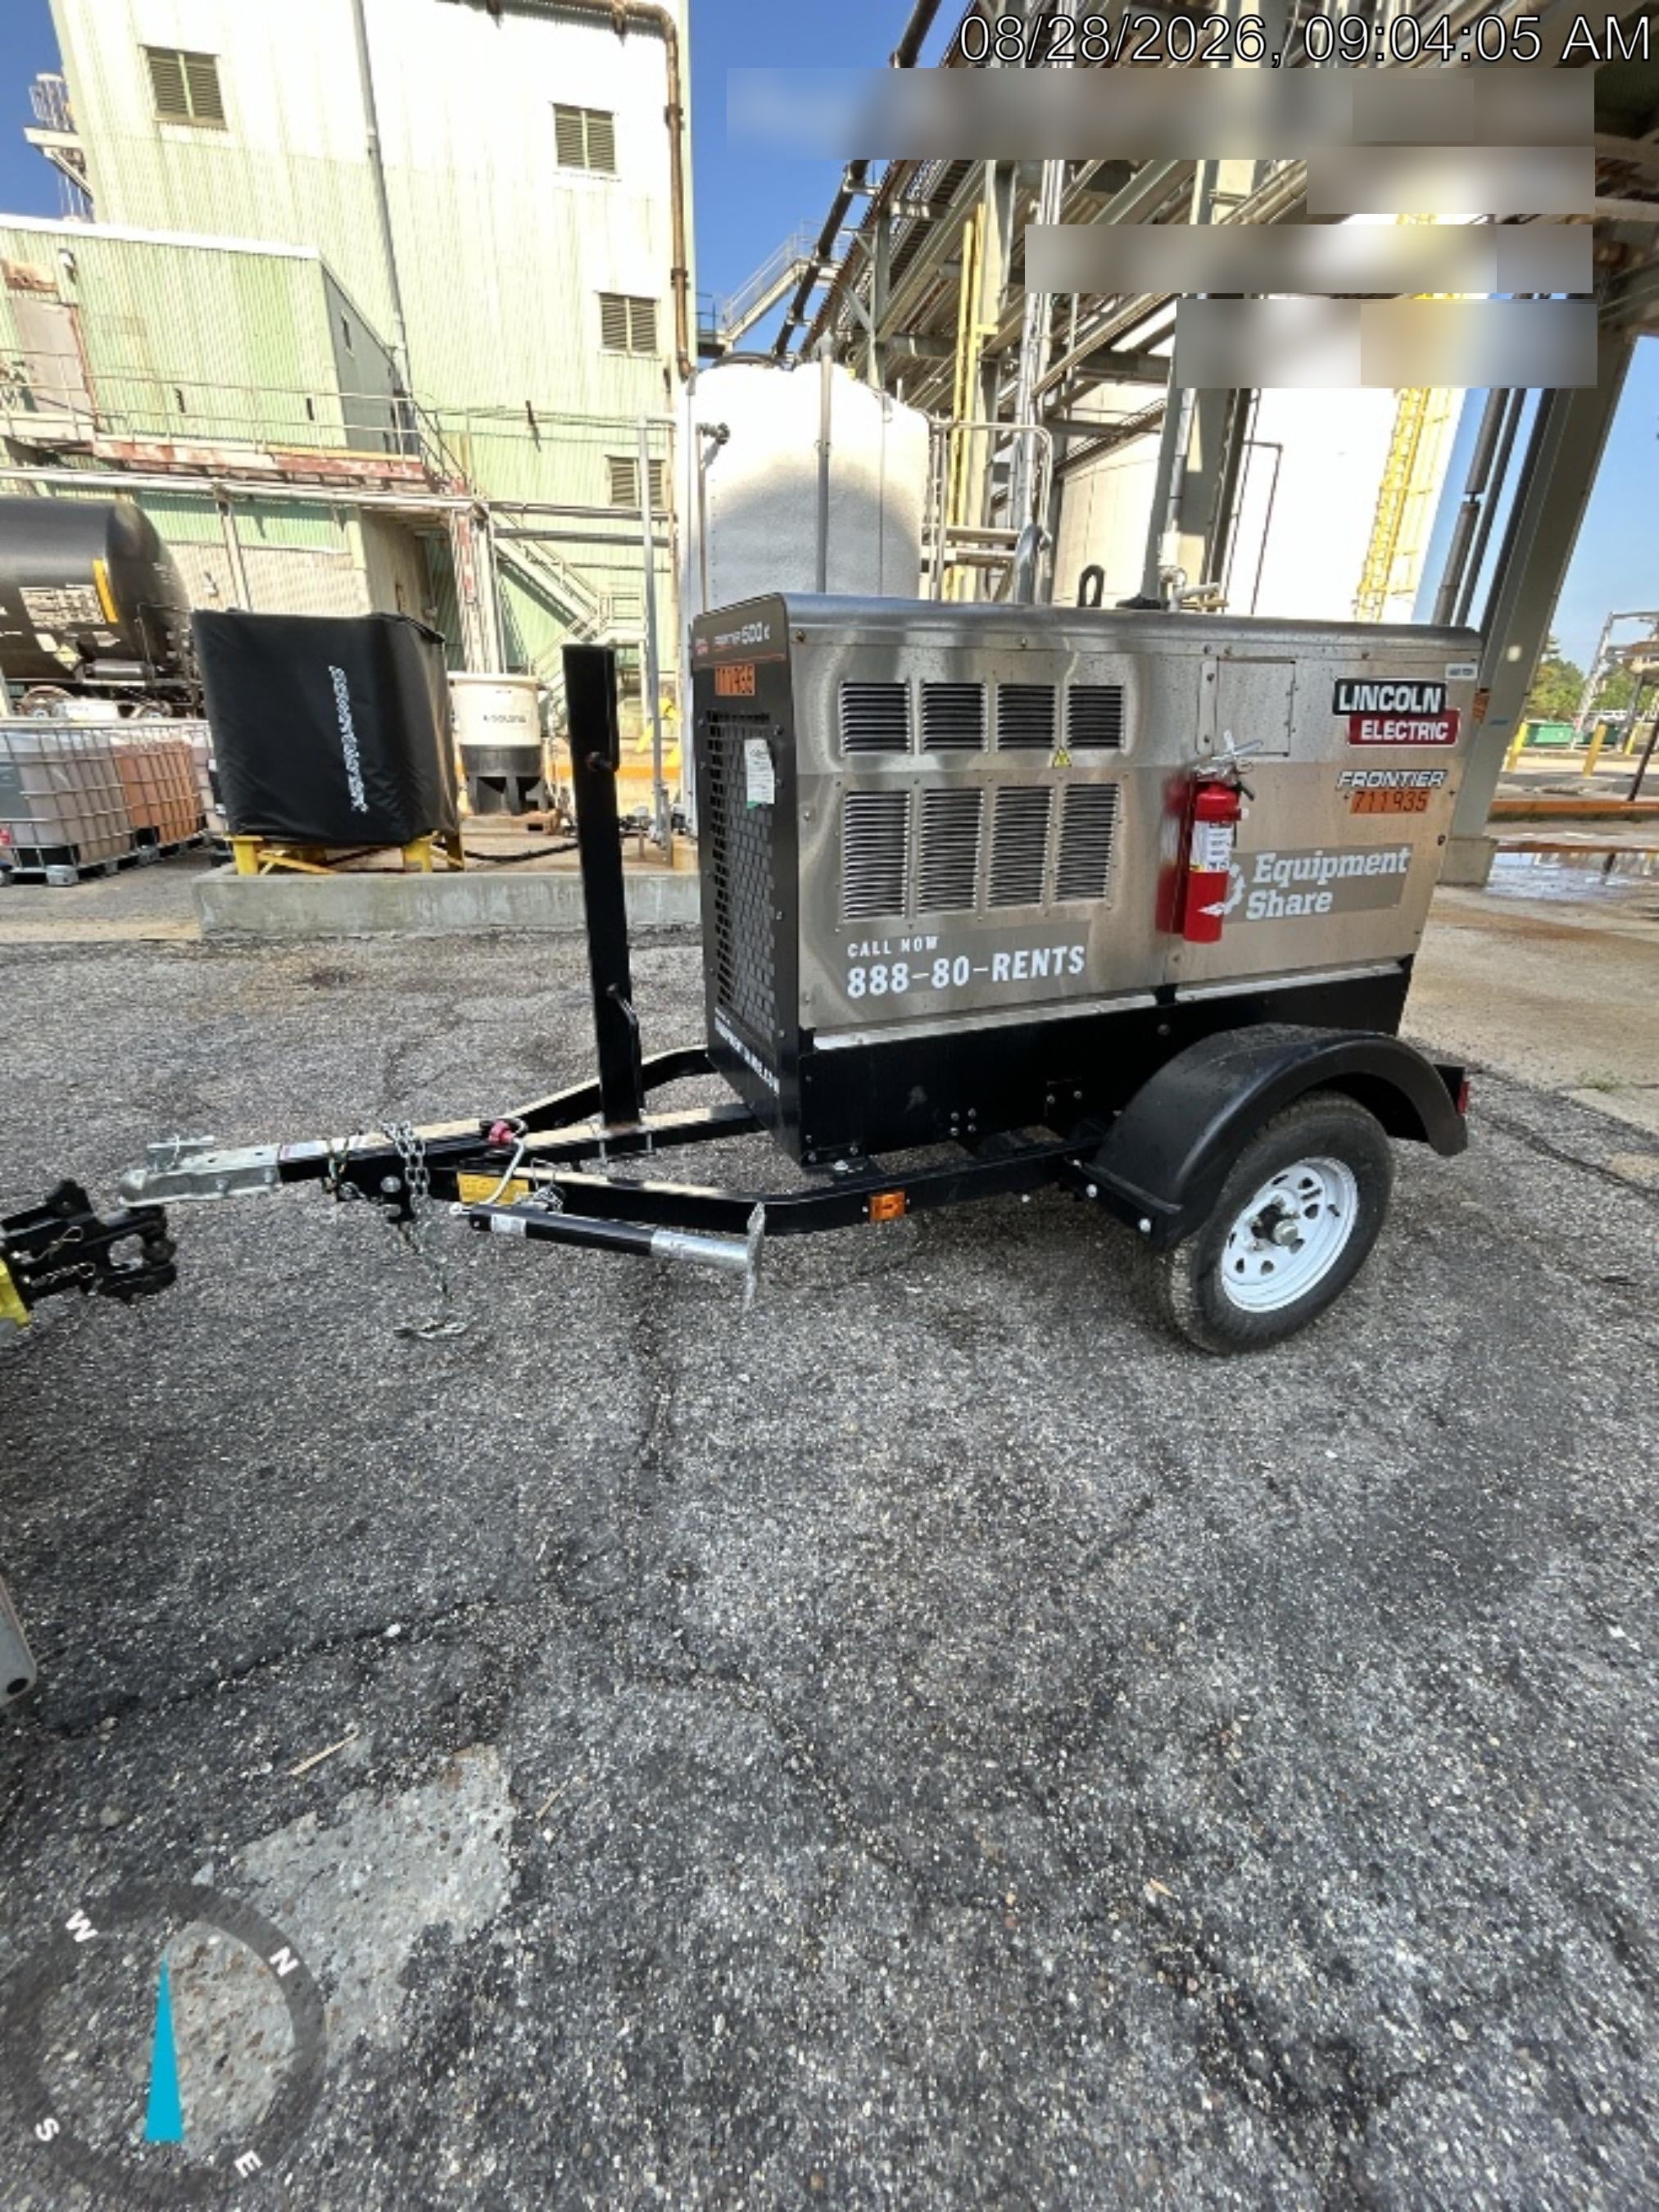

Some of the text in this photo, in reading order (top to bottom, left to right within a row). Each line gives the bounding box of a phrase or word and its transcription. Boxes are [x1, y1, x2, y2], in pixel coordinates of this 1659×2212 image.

[1339, 685, 1441, 714] LINCOLN
[1361, 719, 1448, 741] ELECTRIC
[1336, 769, 1448, 791] FRONTIER
[1353, 791, 1430, 812] 711935
[1252, 846, 1412, 888] Equipment
[1245, 889, 1333, 920] Share
[847, 936, 940, 958] CALL NOW
[847, 945, 1086, 999] 888-80-RENTS
